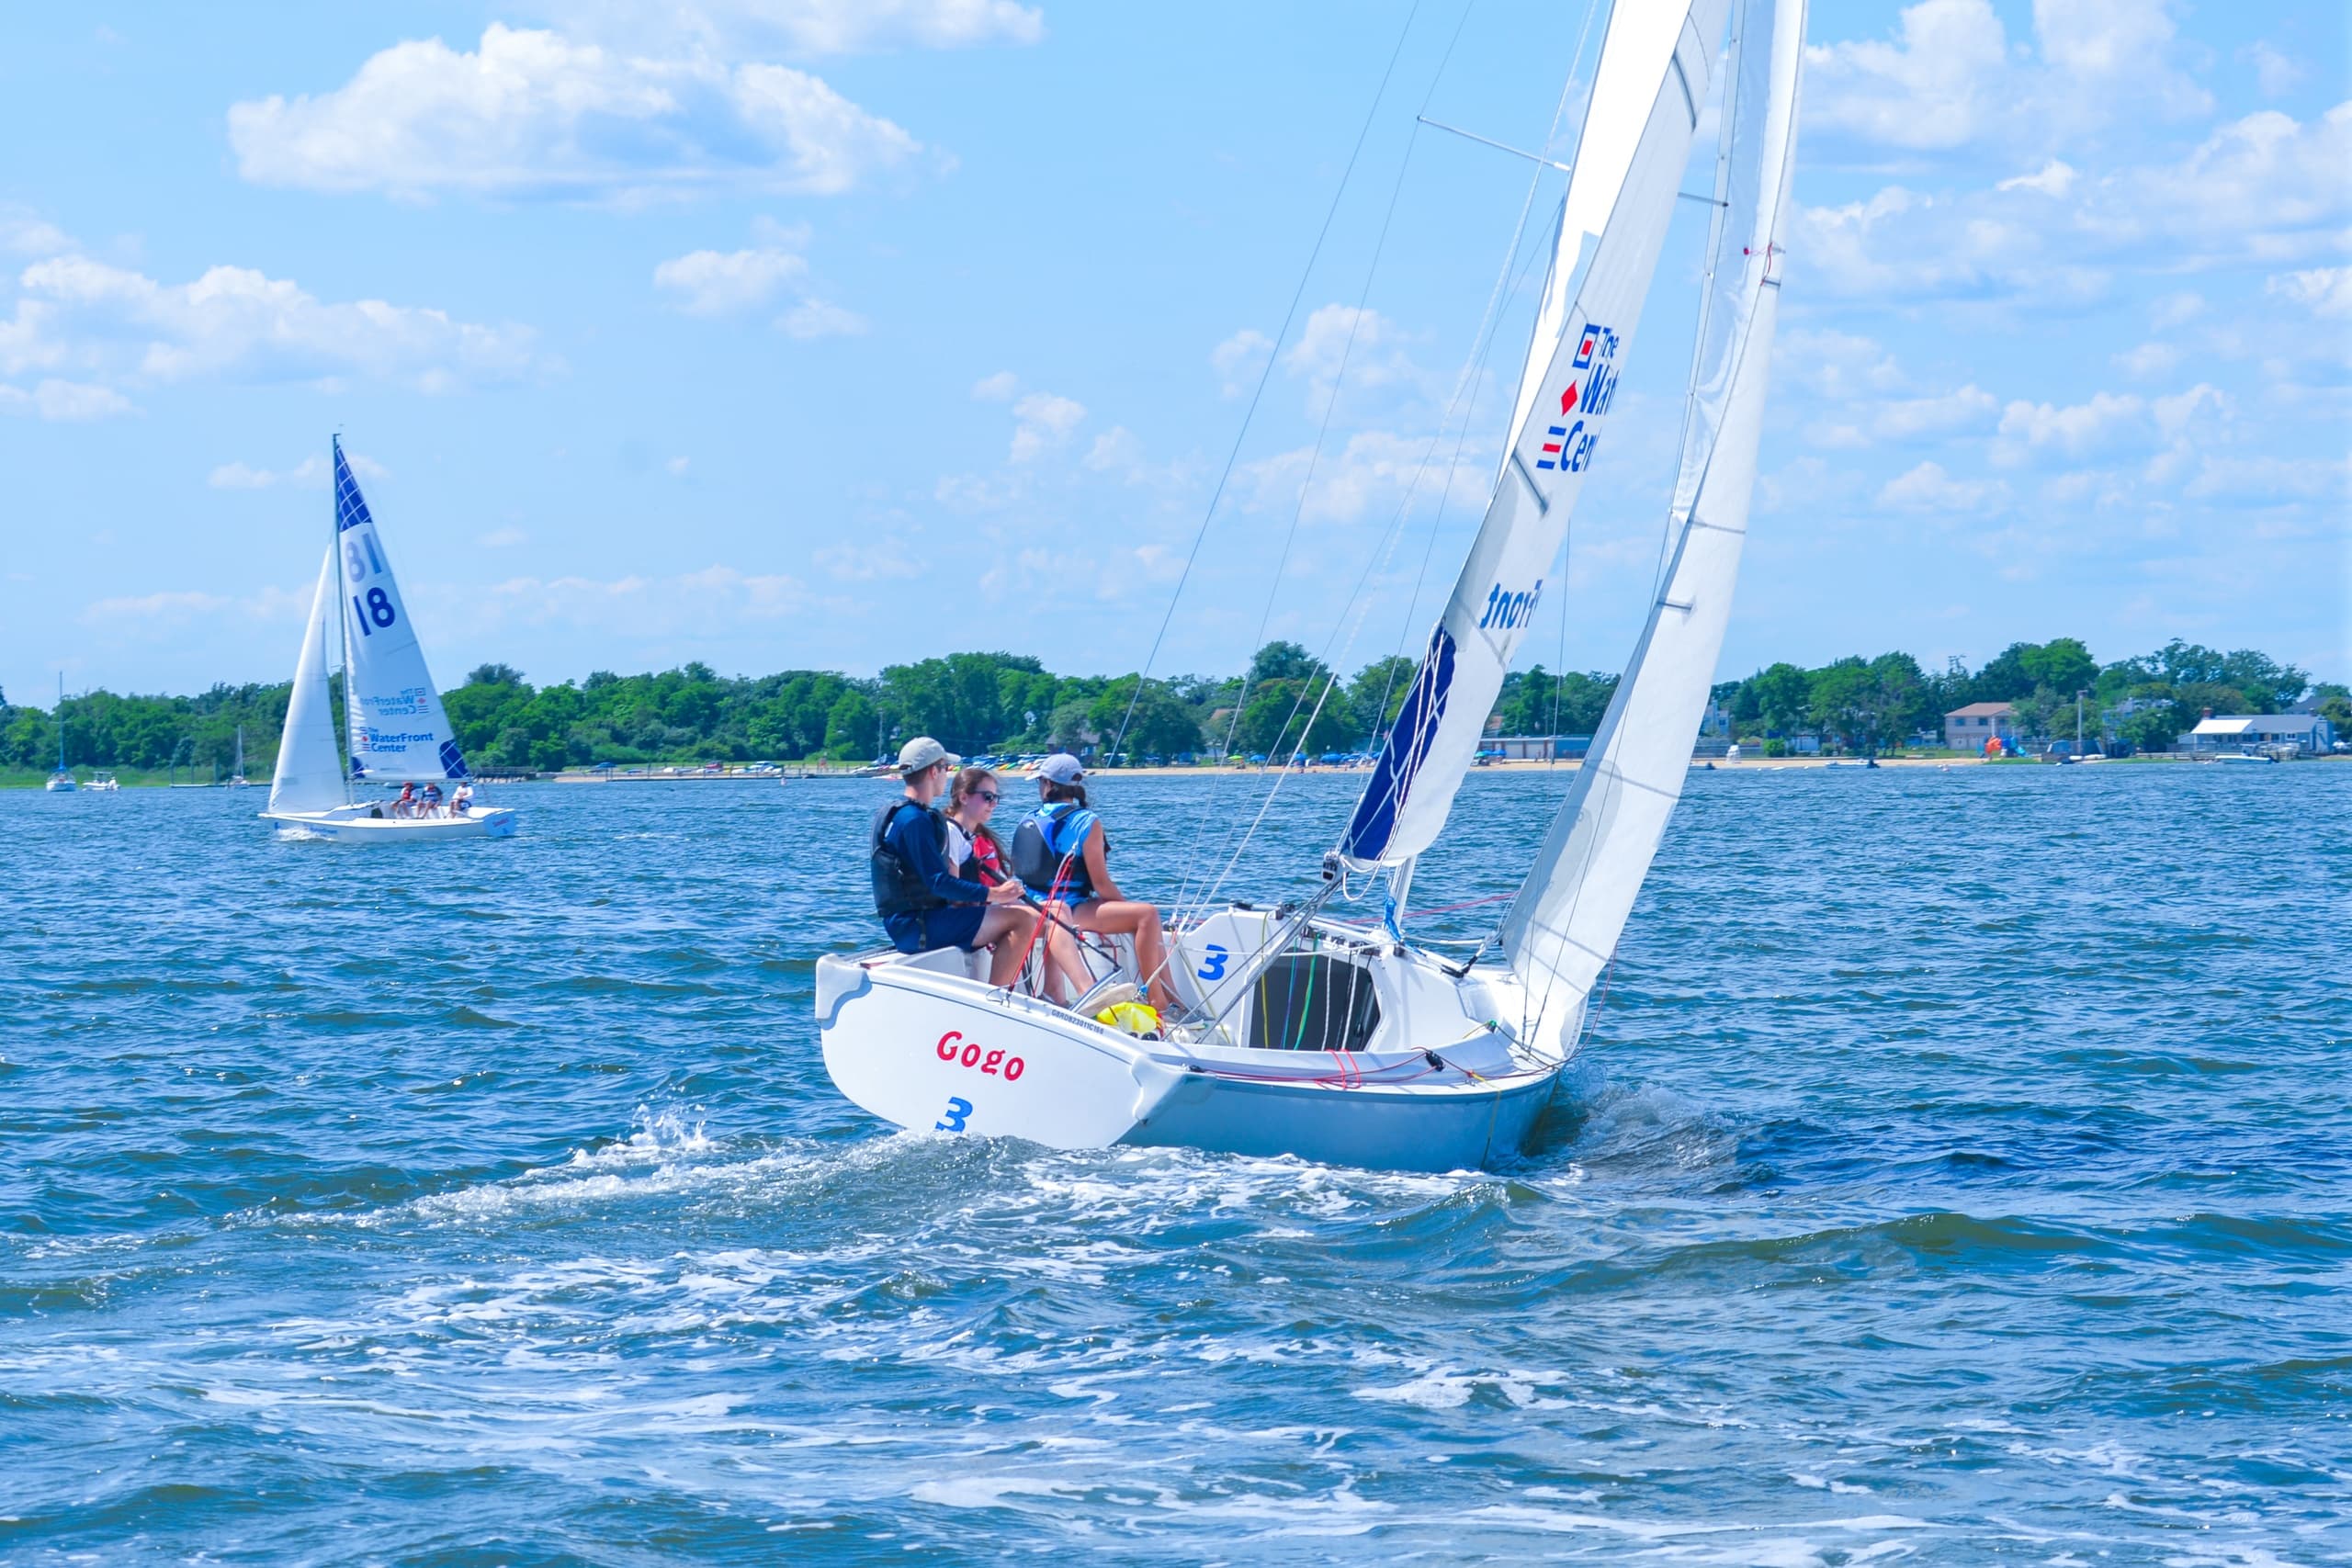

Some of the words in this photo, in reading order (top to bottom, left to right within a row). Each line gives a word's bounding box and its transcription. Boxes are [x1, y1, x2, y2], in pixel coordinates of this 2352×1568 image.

[352, 586, 396, 637] 18
[368, 732, 434, 742] WaterFront
[370, 742, 407, 752] Center
[1197, 943, 1228, 981] 3
[936, 1031, 1025, 1081] Gogo
[934, 1096, 974, 1133] 3
